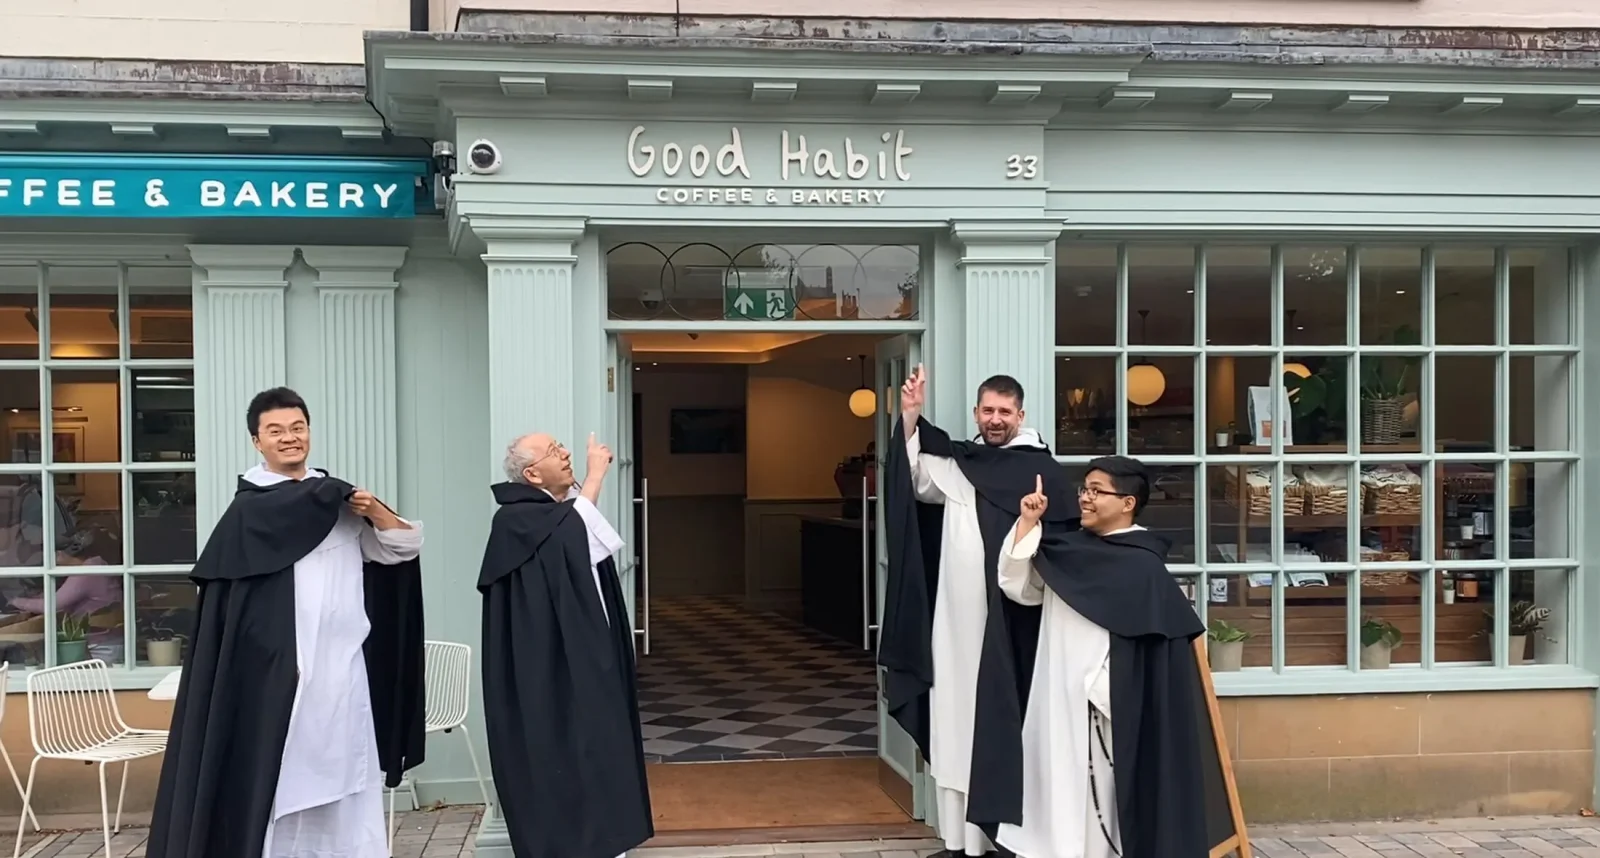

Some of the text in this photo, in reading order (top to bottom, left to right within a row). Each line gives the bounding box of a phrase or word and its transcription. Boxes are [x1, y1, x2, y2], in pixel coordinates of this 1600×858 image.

[626, 125, 914, 181] Good Habit
[1005, 153, 1039, 179] 33
[144, 179, 170, 207] &
[200, 180, 398, 208] BAKERY
[655, 187, 887, 205] COFFEE & BAKERY
